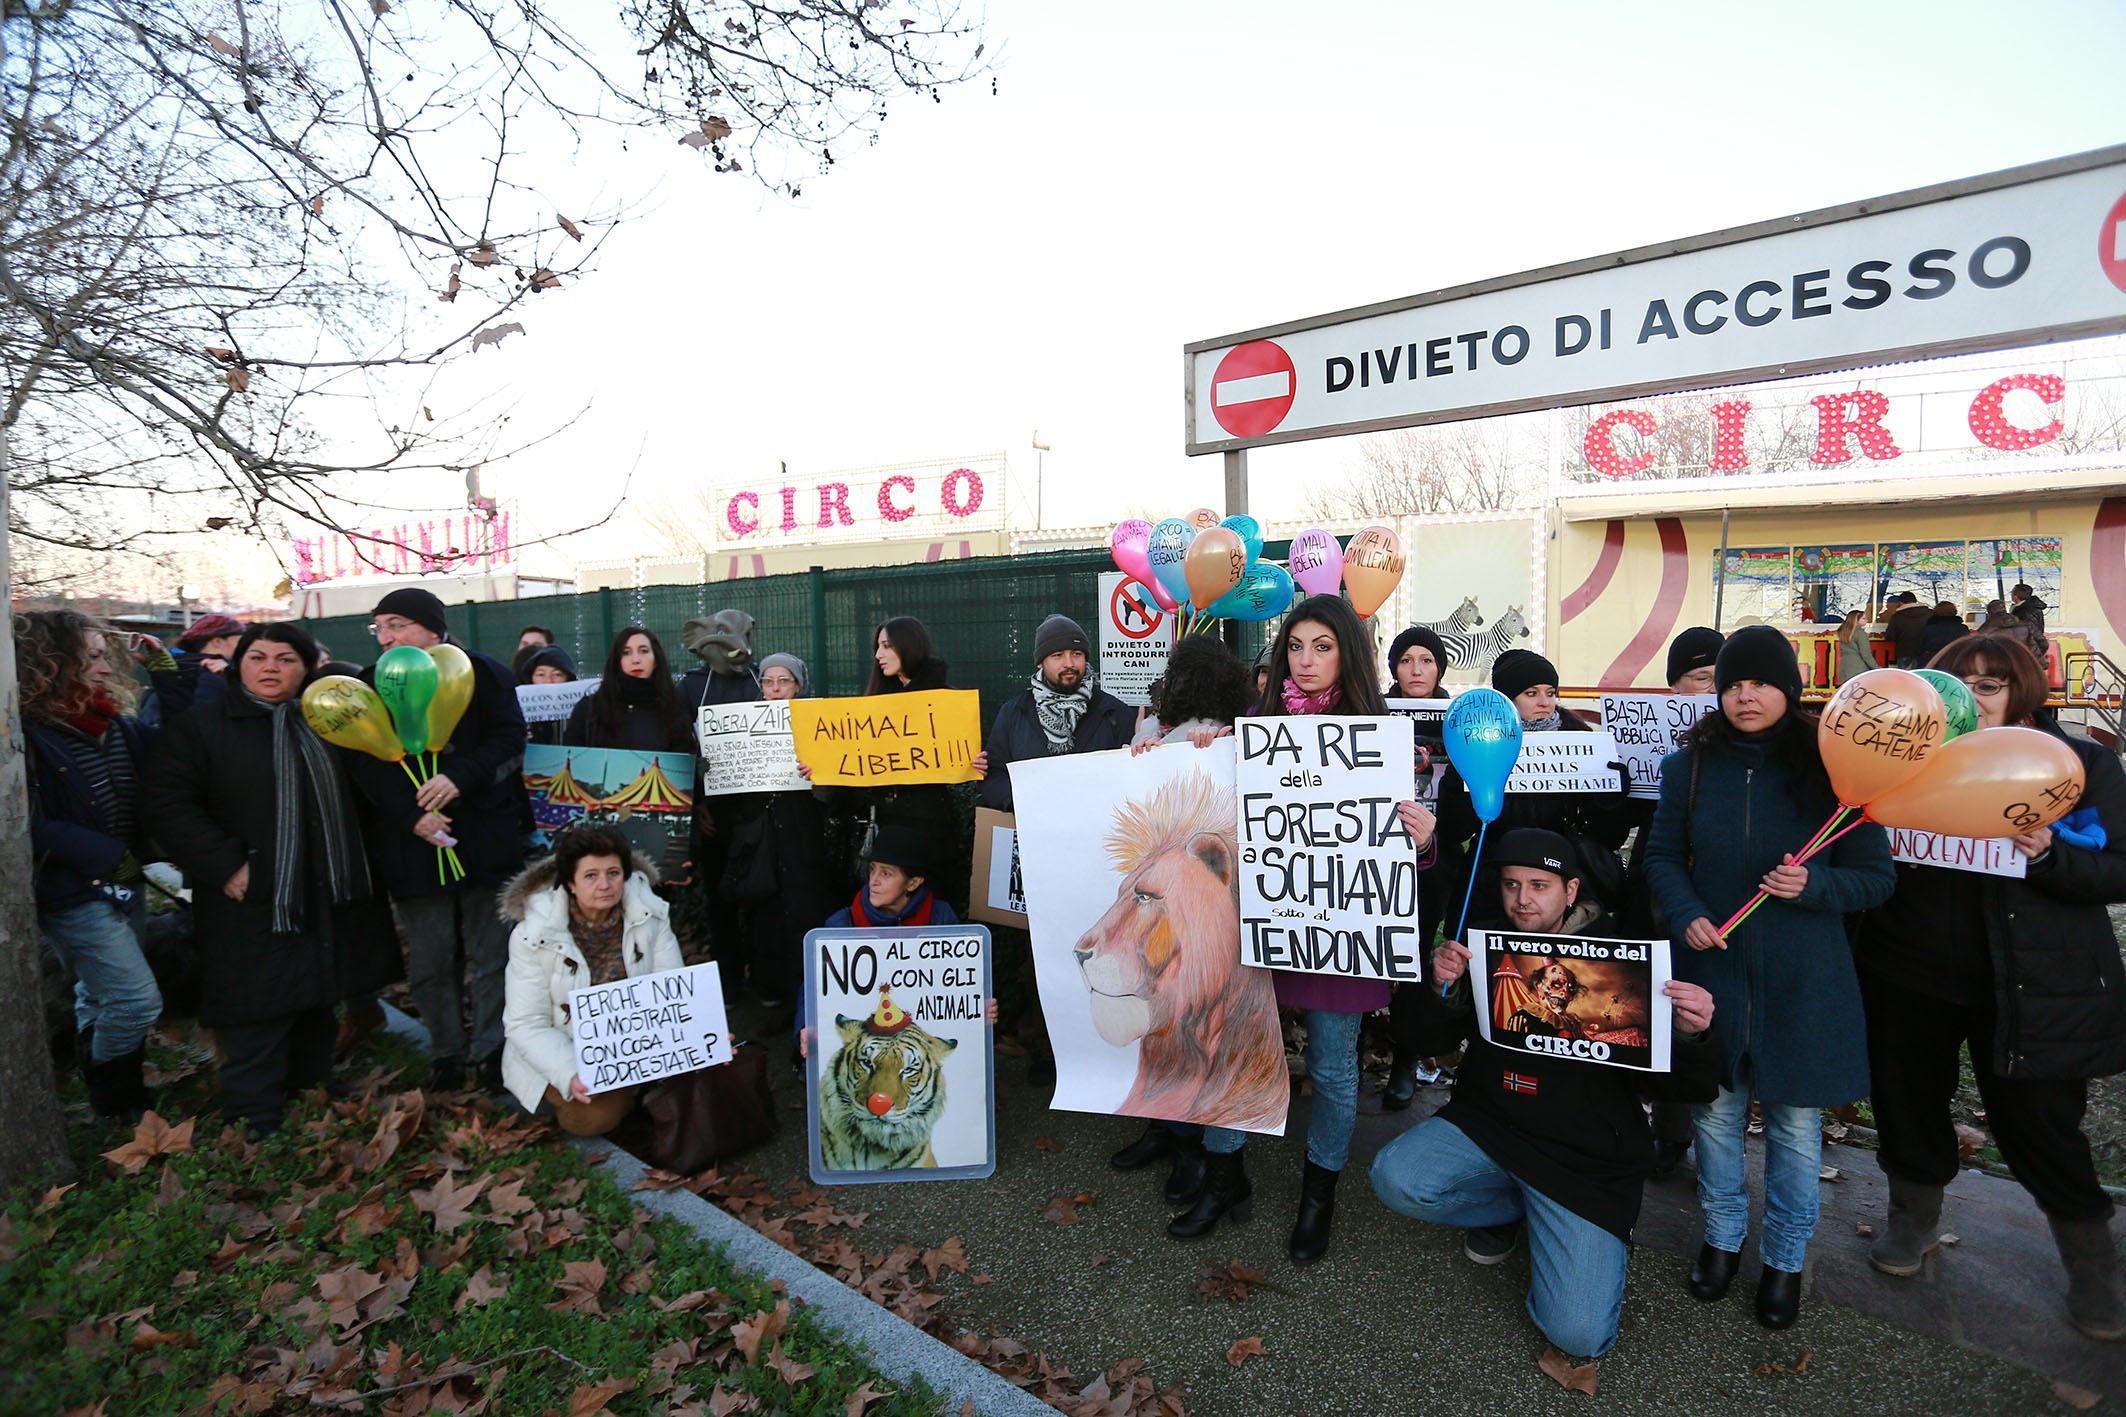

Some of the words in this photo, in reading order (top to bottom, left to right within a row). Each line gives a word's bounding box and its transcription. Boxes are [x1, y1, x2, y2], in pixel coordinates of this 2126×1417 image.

[1325, 324, 1531, 394] DIVIETO
[1554, 308, 1613, 358] DI
[1638, 234, 2033, 345] ACCESSO
[726, 467, 984, 536] CIRCO
[1102, 651, 1171, 659] INTRODURRE
[1107, 641, 1151, 649] DIVIETO
[1155, 641, 1166, 649] DI
[1123, 660, 1150, 668] CANI
[703, 708, 749, 734] POVERA
[814, 703, 936, 742] ANIMALI
[1604, 698, 1659, 727] BASTA
[1242, 722, 1303, 766] DA
[1317, 722, 1384, 771] RE
[1824, 704, 1852, 737] LE
[1852, 721, 1931, 761] CATENE
[1550, 744, 1594, 757] WITH
[1279, 769, 1323, 788] della
[1532, 779, 1554, 791] OF
[1558, 777, 1618, 791] SHAME
[1243, 792, 1414, 850] FORESTA
[1242, 847, 1257, 864] a
[1256, 846, 1416, 918] SCHIAVO
[1010, 901, 1020, 911] LE
[1242, 917, 1418, 979] TENDONE
[1489, 936, 1503, 951] Il
[1508, 940, 1553, 954] vero
[1557, 942, 1609, 959] volto
[1613, 945, 1648, 962] del
[821, 944, 878, 997] NO
[886, 942, 910, 960] AL
[919, 939, 981, 959] CIRCO
[890, 968, 934, 988] CON
[942, 967, 976, 987] GLI
[652, 972, 694, 1005] NON
[578, 1018, 599, 1041] CI
[606, 1003, 692, 1037] MOSTRATE
[916, 994, 981, 1021] ANIMALI
[581, 1041, 617, 1066] CON
[620, 1033, 663, 1057] COSA
[671, 1027, 685, 1044] LI
[1525, 1034, 1611, 1061] CIRCO
